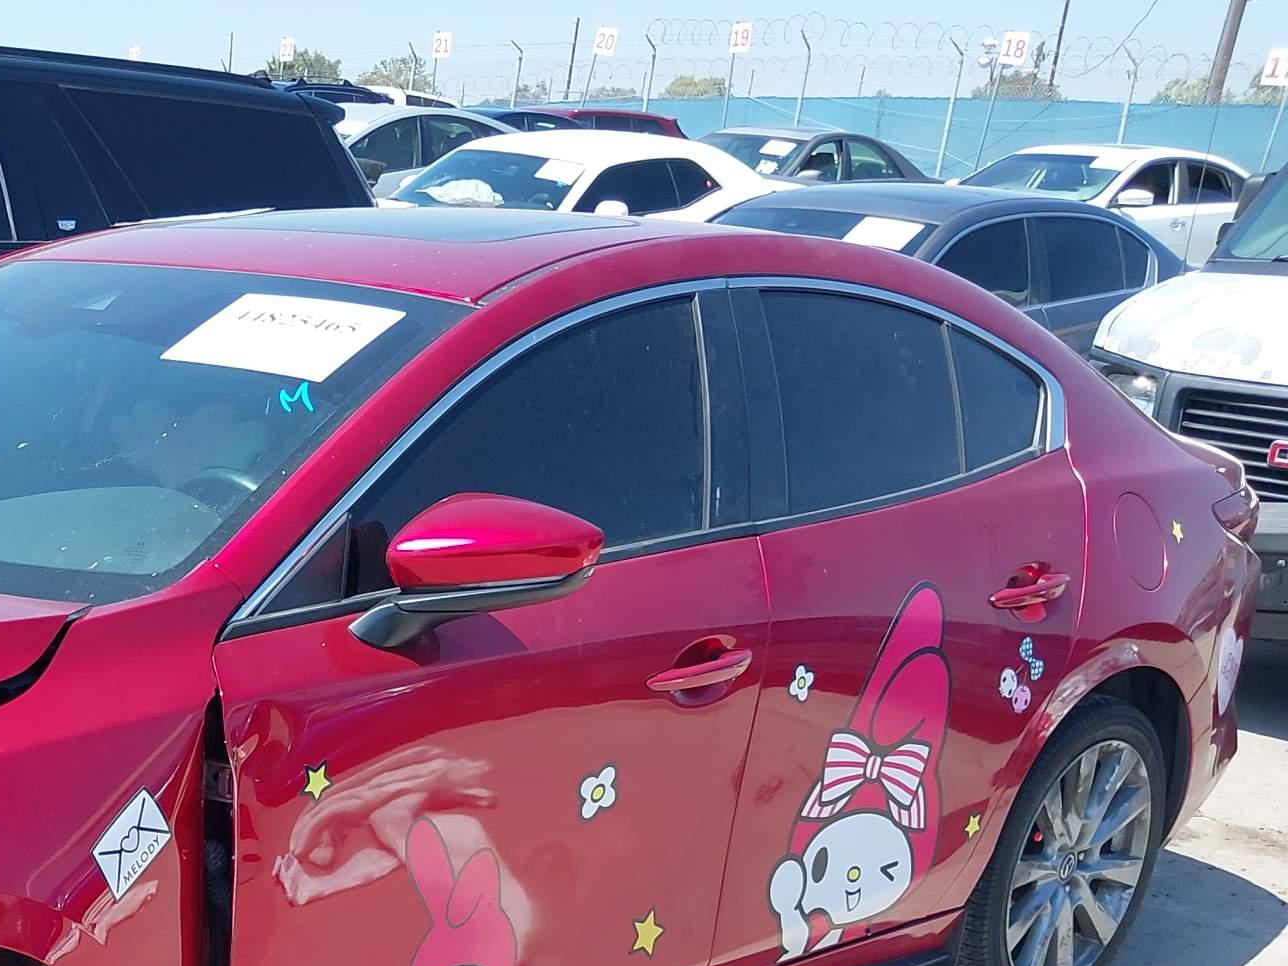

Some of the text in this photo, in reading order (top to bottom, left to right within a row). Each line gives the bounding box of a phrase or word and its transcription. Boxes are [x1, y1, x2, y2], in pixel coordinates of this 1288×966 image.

[434, 38, 449, 53] 21
[596, 33, 615, 50] 20
[733, 29, 749, 47] 19
[1002, 39, 1026, 58] 18
[1264, 57, 1288, 79] 1
[279, 382, 314, 412] M
[123, 834, 160, 886] MELODY
